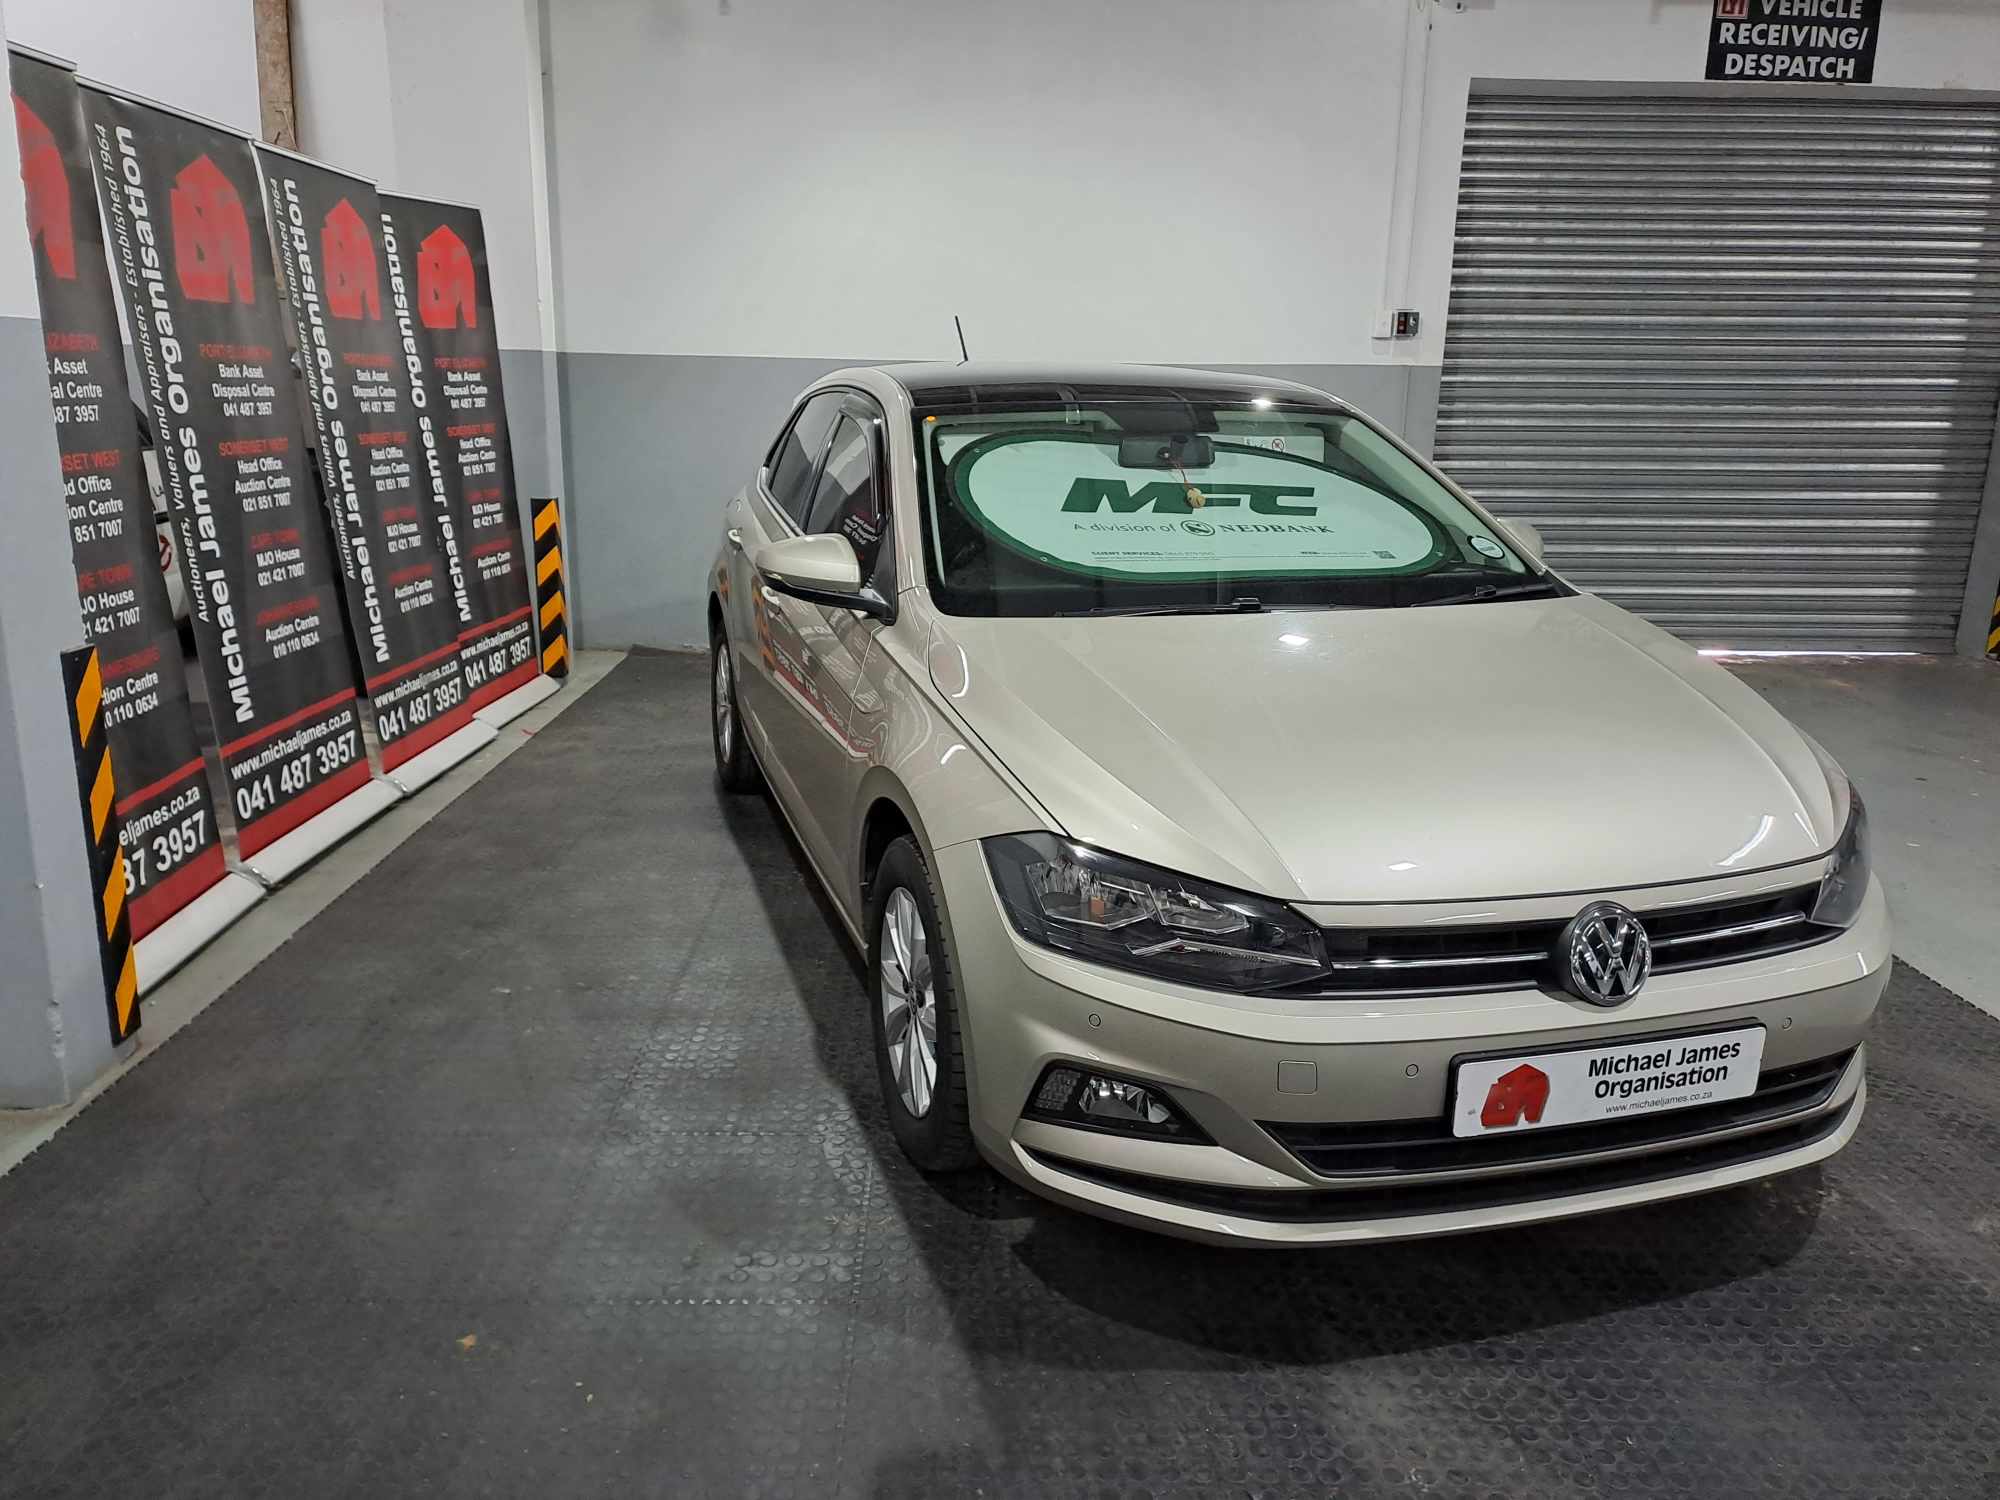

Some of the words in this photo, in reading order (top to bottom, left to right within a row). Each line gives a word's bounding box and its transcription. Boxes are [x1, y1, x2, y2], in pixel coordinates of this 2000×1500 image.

[1761, 0, 1862, 19] VEHICLE
[1719, 22, 1869, 50] RECEIVING/
[1724, 53, 1855, 79] DESPATCH
[94, 123, 114, 172] 1964
[105, 176, 138, 288] Established
[115, 126, 189, 415] Organisation
[283, 178, 338, 410] Organisation
[54, 357, 88, 375] Asset
[134, 303, 163, 402] Appraisers
[218, 364, 241, 378] Bank
[242, 364, 264, 379] Asset
[66, 381, 103, 399] Centre
[212, 383, 250, 400] Disposal
[74, 404, 99, 422] 3957
[152, 404, 171, 441] and
[223, 402, 239, 417] 041
[164, 445, 186, 511] Valuers
[237, 458, 259, 475] Head
[259, 456, 283, 472] Office
[330, 420, 363, 528] James
[419, 416, 448, 507] James
[77, 475, 112, 495] Office
[178, 426, 221, 559] James
[234, 478, 267, 494] Auction
[1060, 477, 1318, 517] MFC
[88, 498, 123, 517] Centre
[242, 497, 257, 513] 021
[74, 521, 96, 543] 851
[98, 518, 122, 537] 7007
[1073, 522, 1084, 532] A
[1089, 521, 1156, 533] division
[1218, 523, 1336, 535] NEDBANK
[274, 548, 300, 563] House
[438, 514, 472, 623] Michael
[257, 570, 272, 587] 021
[98, 588, 135, 611] House
[351, 537, 390, 664] Michael
[94, 612, 115, 634] 421
[117, 606, 141, 626] 7007
[265, 623, 295, 642] Auction
[205, 569, 254, 724] Michael
[465, 659, 487, 689] 041
[488, 649, 506, 676] 487
[509, 636, 531, 666] 3957
[126, 670, 159, 695] Centre
[374, 659, 459, 709] www.michaeljames.co.za
[113, 701, 134, 725] 110
[135, 690, 159, 715] 0634
[379, 706, 407, 741] 041
[409, 692, 432, 725] 487
[433, 676, 462, 711] 3957
[230, 708, 352, 780] www.michaeljames.co.za
[236, 773, 276, 820] 041
[280, 753, 312, 795] 487
[315, 729, 356, 775] 3957
[118, 785, 200, 847] eljames.co.za
[152, 809, 206, 872] 3957
[1587, 1048, 1670, 1078] Michael
[1675, 1040, 1741, 1066] James
[1594, 1062, 1728, 1099] Organisation
[1604, 1089, 1713, 1115] www.michaeljames.co.za
